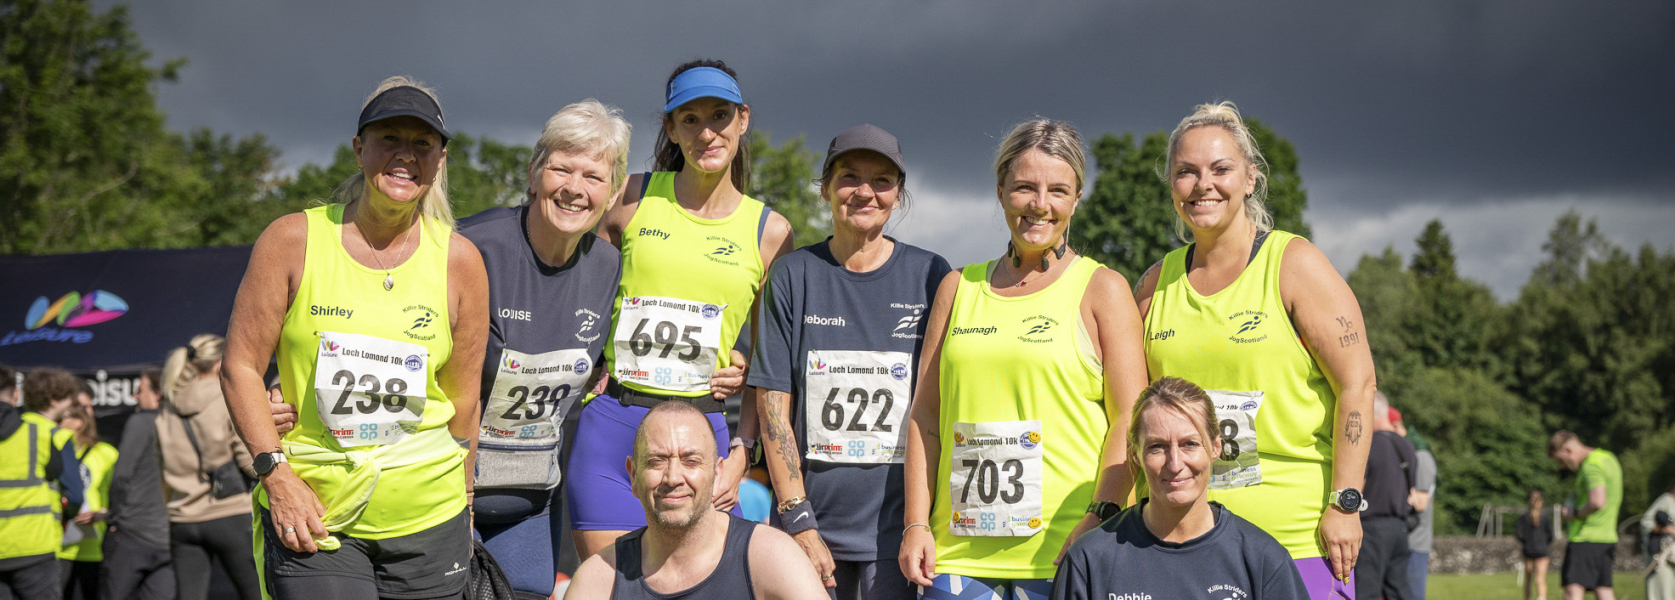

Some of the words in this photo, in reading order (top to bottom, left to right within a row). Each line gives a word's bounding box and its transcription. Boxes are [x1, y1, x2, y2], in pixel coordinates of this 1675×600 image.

[639, 228, 670, 240] Bethy
[311, 305, 354, 319] Shirley
[418, 304, 439, 317] Striders
[642, 299, 657, 307] Loch
[659, 300, 686, 311] Lomond
[688, 304, 700, 313] 10k
[1038, 314, 1059, 326] Striders
[1229, 311, 1244, 320] Killie
[1245, 310, 1268, 318] Striders
[0, 327, 94, 346] Leisure
[952, 326, 997, 336] Shaunagh
[1150, 329, 1175, 341] Leigh
[629, 318, 702, 361] 695
[1229, 334, 1267, 344] JogScotland
[1339, 332, 1360, 348] 1991
[342, 347, 359, 357] Loch
[361, 350, 389, 363] Lomond
[391, 356, 403, 366] 10k
[521, 366, 537, 375] Loch
[538, 364, 560, 374] Lomond
[561, 364, 573, 372] 10k
[829, 365, 846, 374] Loch
[847, 366, 874, 375] Lomond
[876, 366, 889, 375] 10k
[331, 370, 407, 414] 238
[500, 384, 571, 420] 239
[821, 387, 894, 432] 622
[1005, 437, 1018, 445] 10k
[1219, 419, 1240, 461] 8
[960, 459, 1024, 504] 703
[1108, 592, 1152, 600] Debbie
[1207, 584, 1223, 594] Killie
[1224, 584, 1247, 598] Striders
